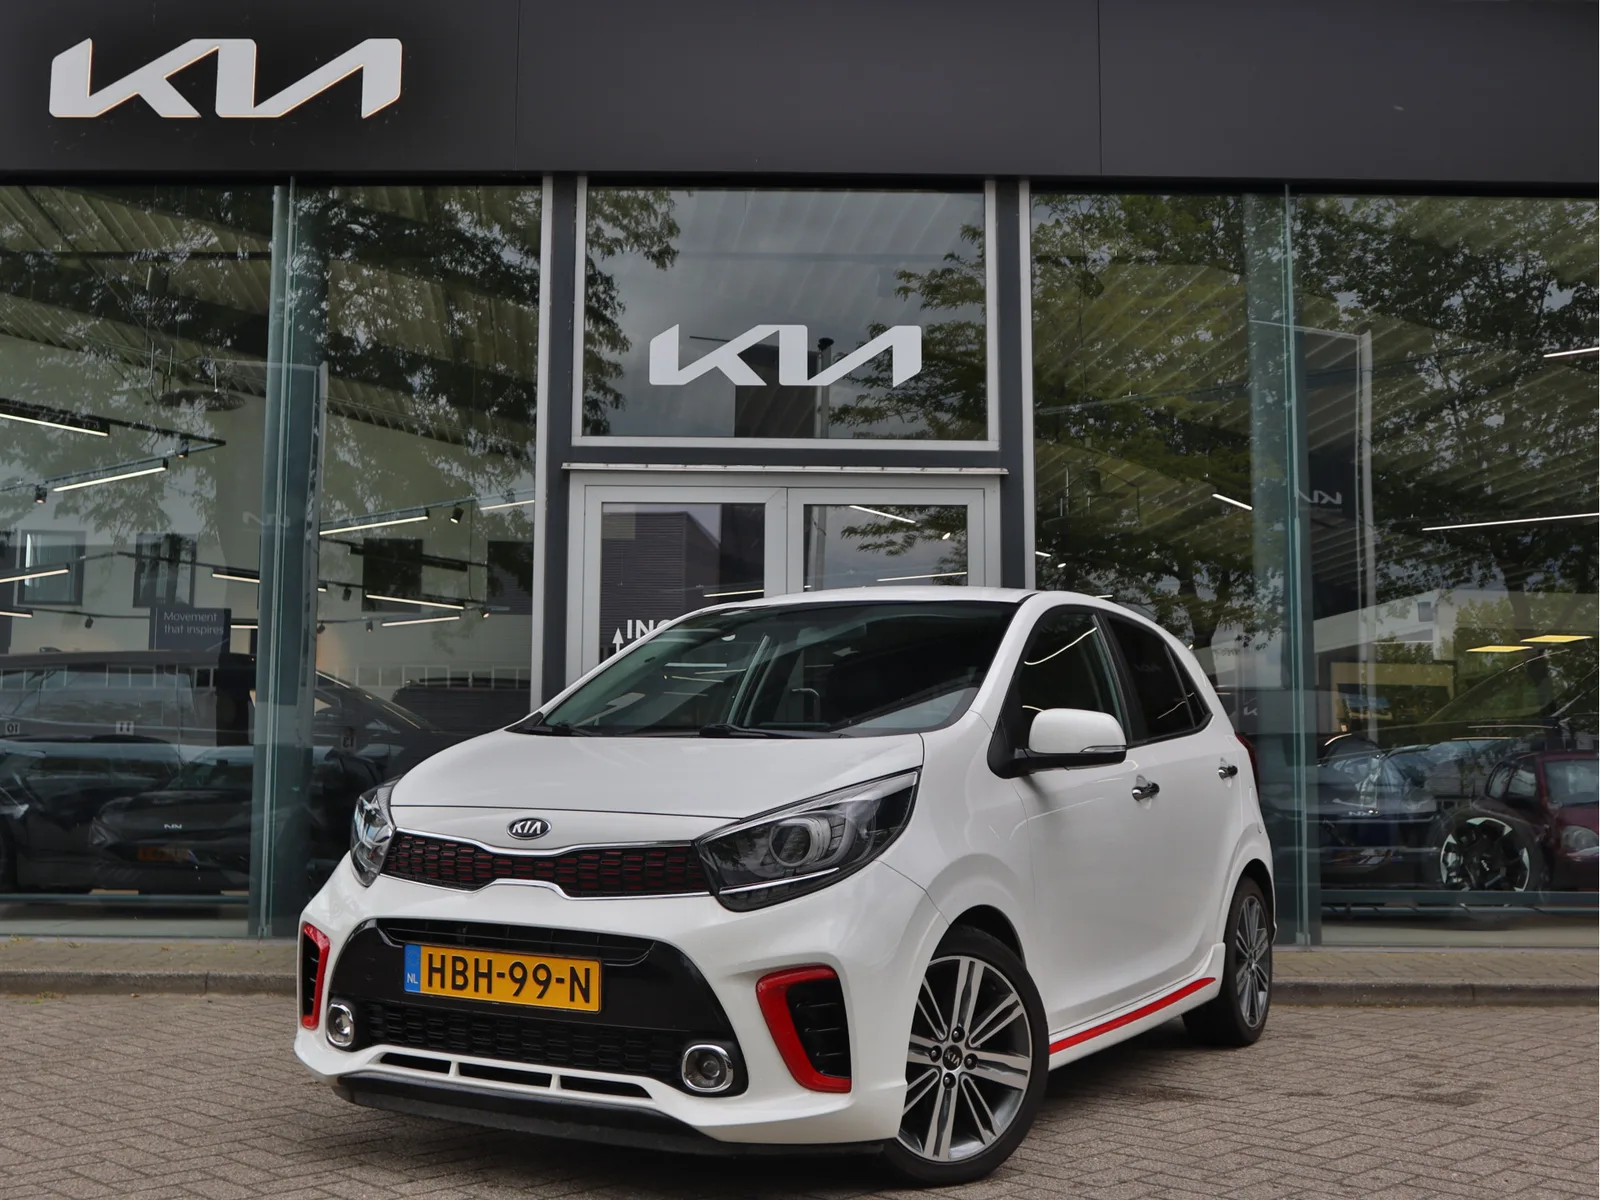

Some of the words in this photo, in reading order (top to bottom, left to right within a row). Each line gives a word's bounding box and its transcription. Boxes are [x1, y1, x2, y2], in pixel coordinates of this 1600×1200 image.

[49, 38, 402, 118] KIA
[649, 324, 922, 387] KIA
[163, 611, 218, 622] Movement
[163, 623, 184, 634] that
[186, 624, 224, 636] inspires
[511, 820, 542, 834] KIA
[406, 973, 419, 984] NL
[427, 953, 591, 1003] HBH-99-N
[944, 1049, 960, 1067] KIA
